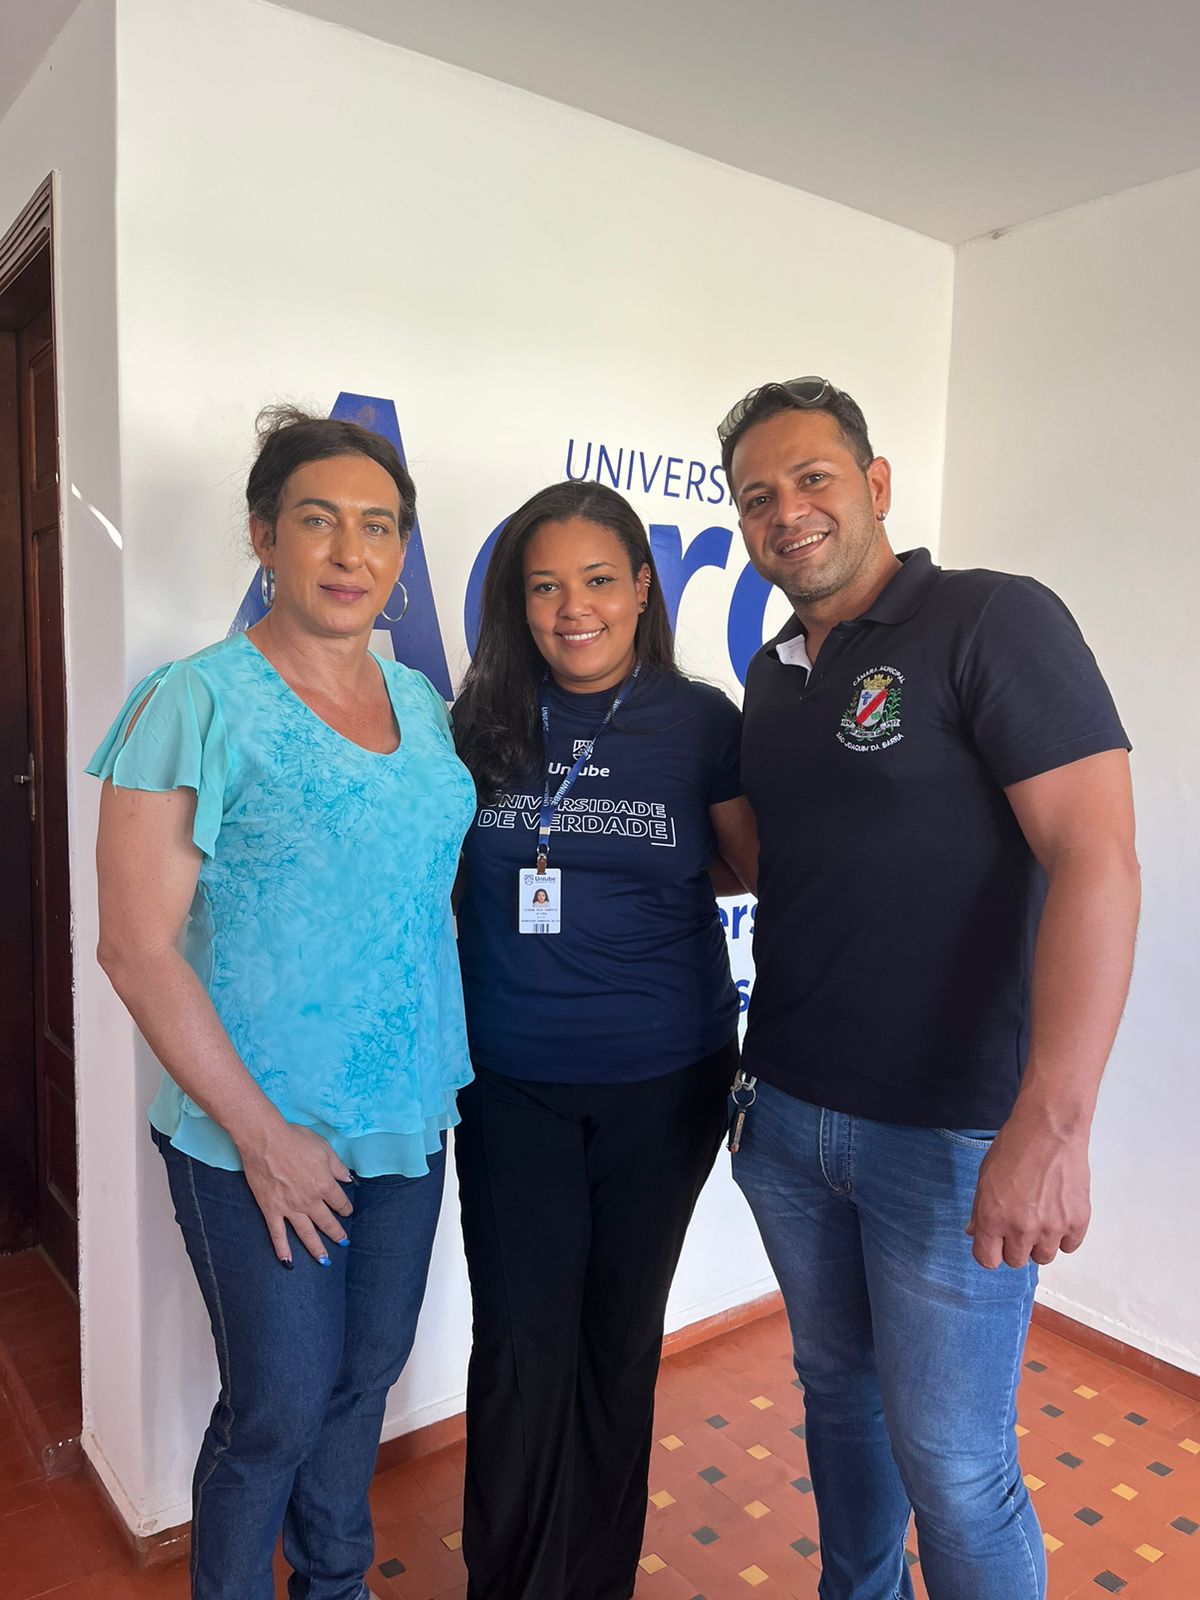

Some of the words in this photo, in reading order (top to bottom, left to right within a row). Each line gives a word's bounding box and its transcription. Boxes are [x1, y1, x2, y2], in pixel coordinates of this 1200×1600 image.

[566, 439, 733, 506] UNIVERS
[548, 762, 610, 777] Unube
[488, 788, 667, 819] NIVRSIDADE
[477, 809, 517, 829] DE
[521, 812, 668, 839] VERDADE
